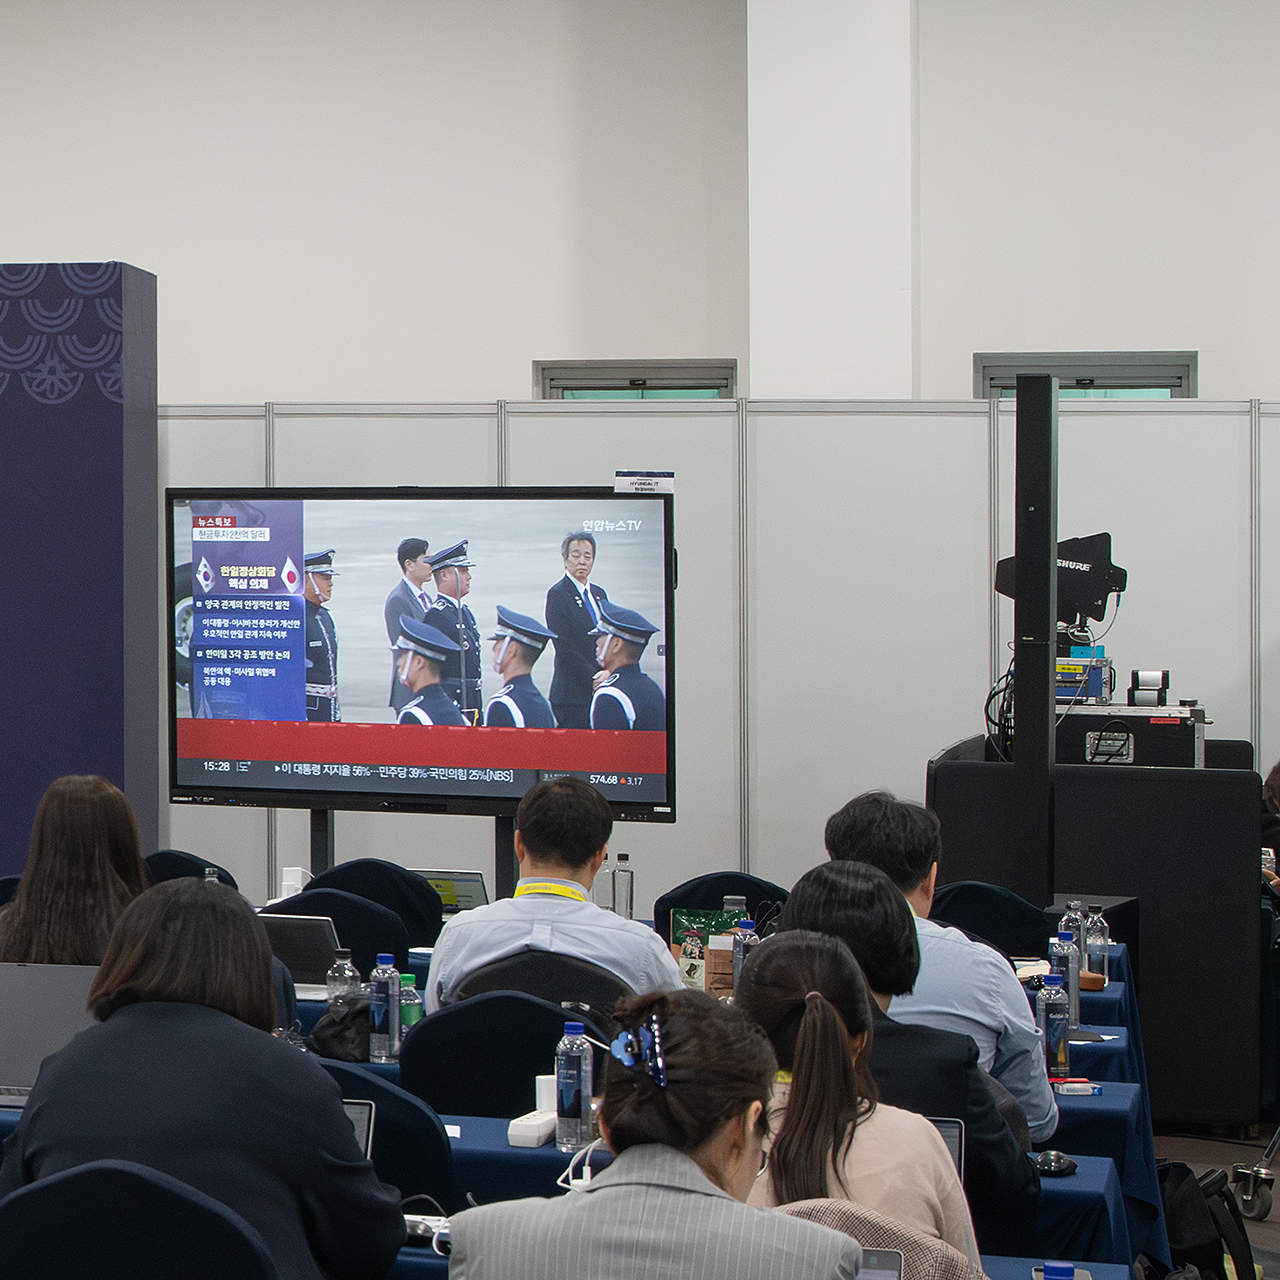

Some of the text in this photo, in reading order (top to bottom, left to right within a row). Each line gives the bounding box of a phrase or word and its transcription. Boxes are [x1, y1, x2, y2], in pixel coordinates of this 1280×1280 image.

[198, 517, 232, 527] 뉴스특보
[582, 519, 642, 532] 연합뉴스TV
[1057, 559, 1091, 572] SHURE
[220, 566, 277, 577] 한일정상회담
[228, 578, 269, 589] 핵심 의제
[204, 599, 220, 609] 양국
[244, 600, 274, 610] 안정적인
[274, 600, 290, 610] 발전
[242, 650, 258, 660] 공조
[274, 650, 291, 660] 논의
[203, 761, 231, 772] 15:28
[281, 763, 292, 775] 이
[293, 764, 321, 776] 대통령
[322, 765, 351, 777] 지지율
[468, 769, 514, 782] 25%[NBS]
[590, 774, 643, 786] 574.68 3.17
